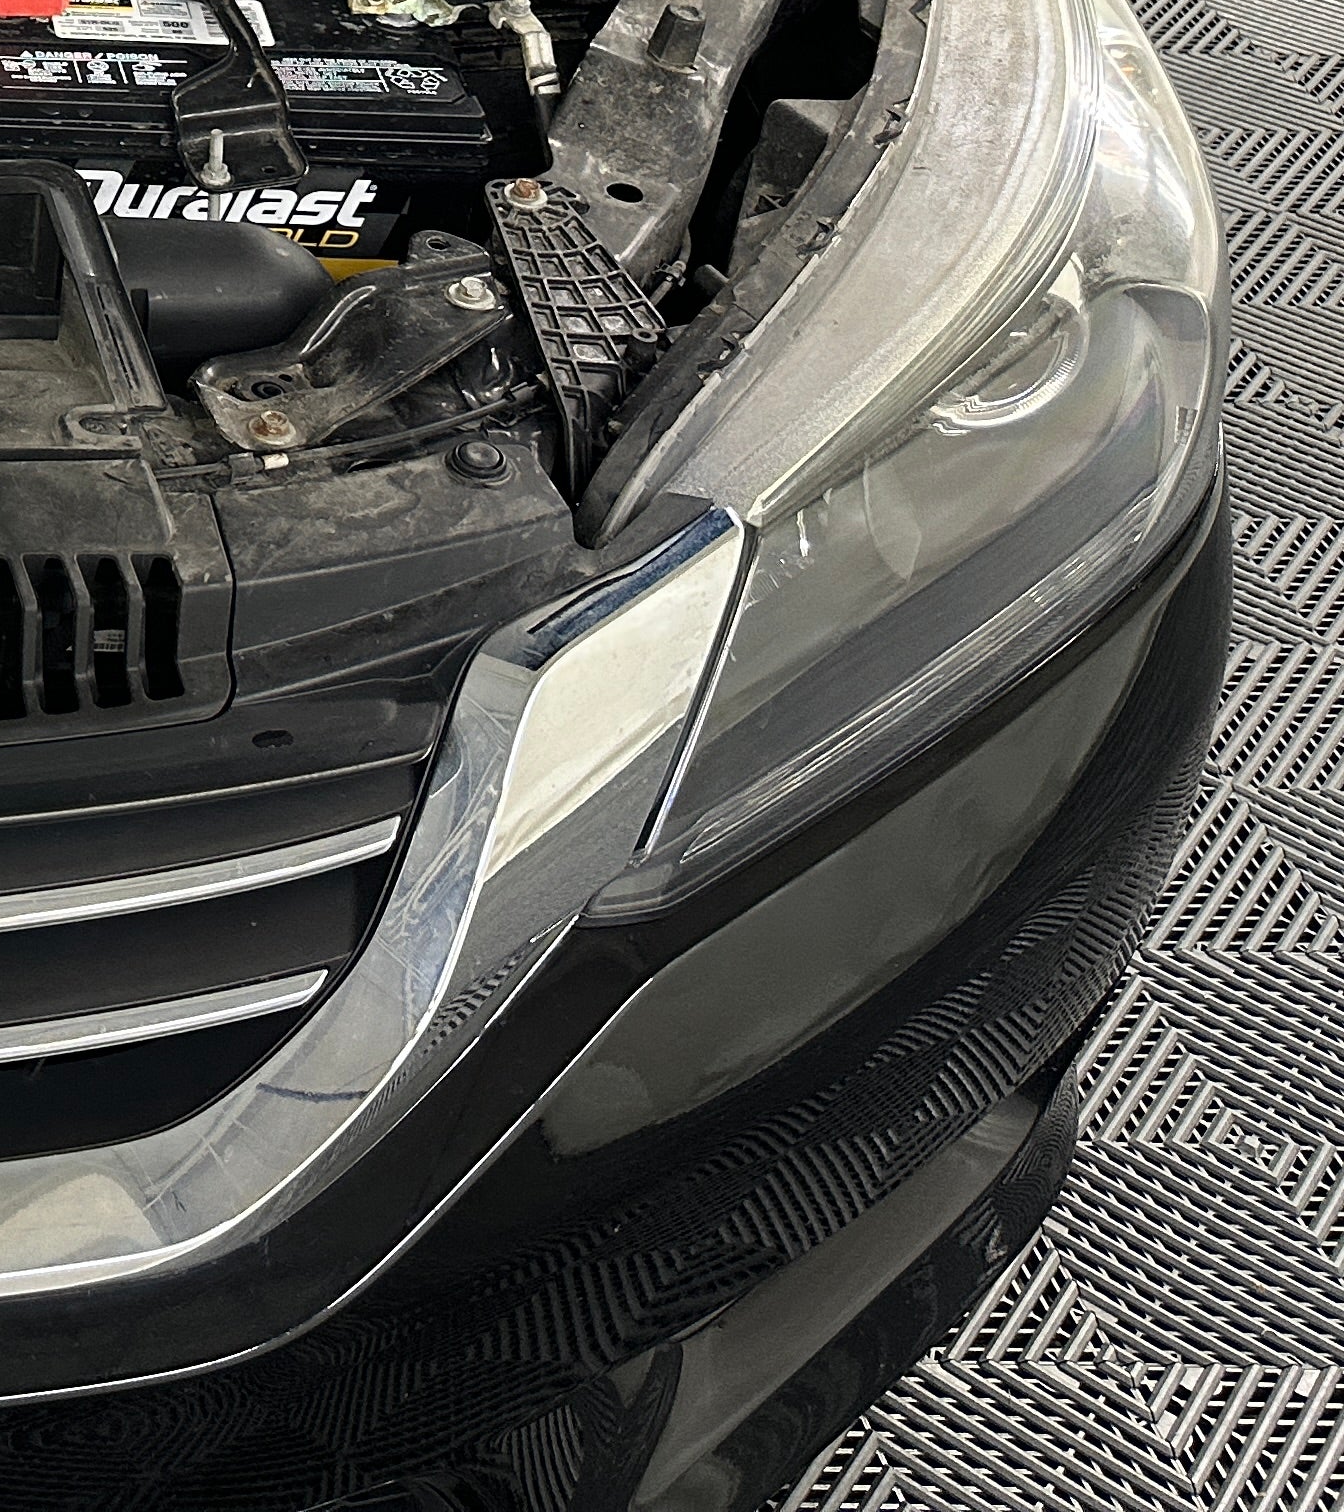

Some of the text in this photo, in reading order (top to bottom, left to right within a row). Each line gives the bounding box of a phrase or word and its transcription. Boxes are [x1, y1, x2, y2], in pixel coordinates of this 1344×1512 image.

[34, 50, 92, 60] DANGER
[106, 52, 159, 62] POISON
[73, 168, 375, 227] Duralast
